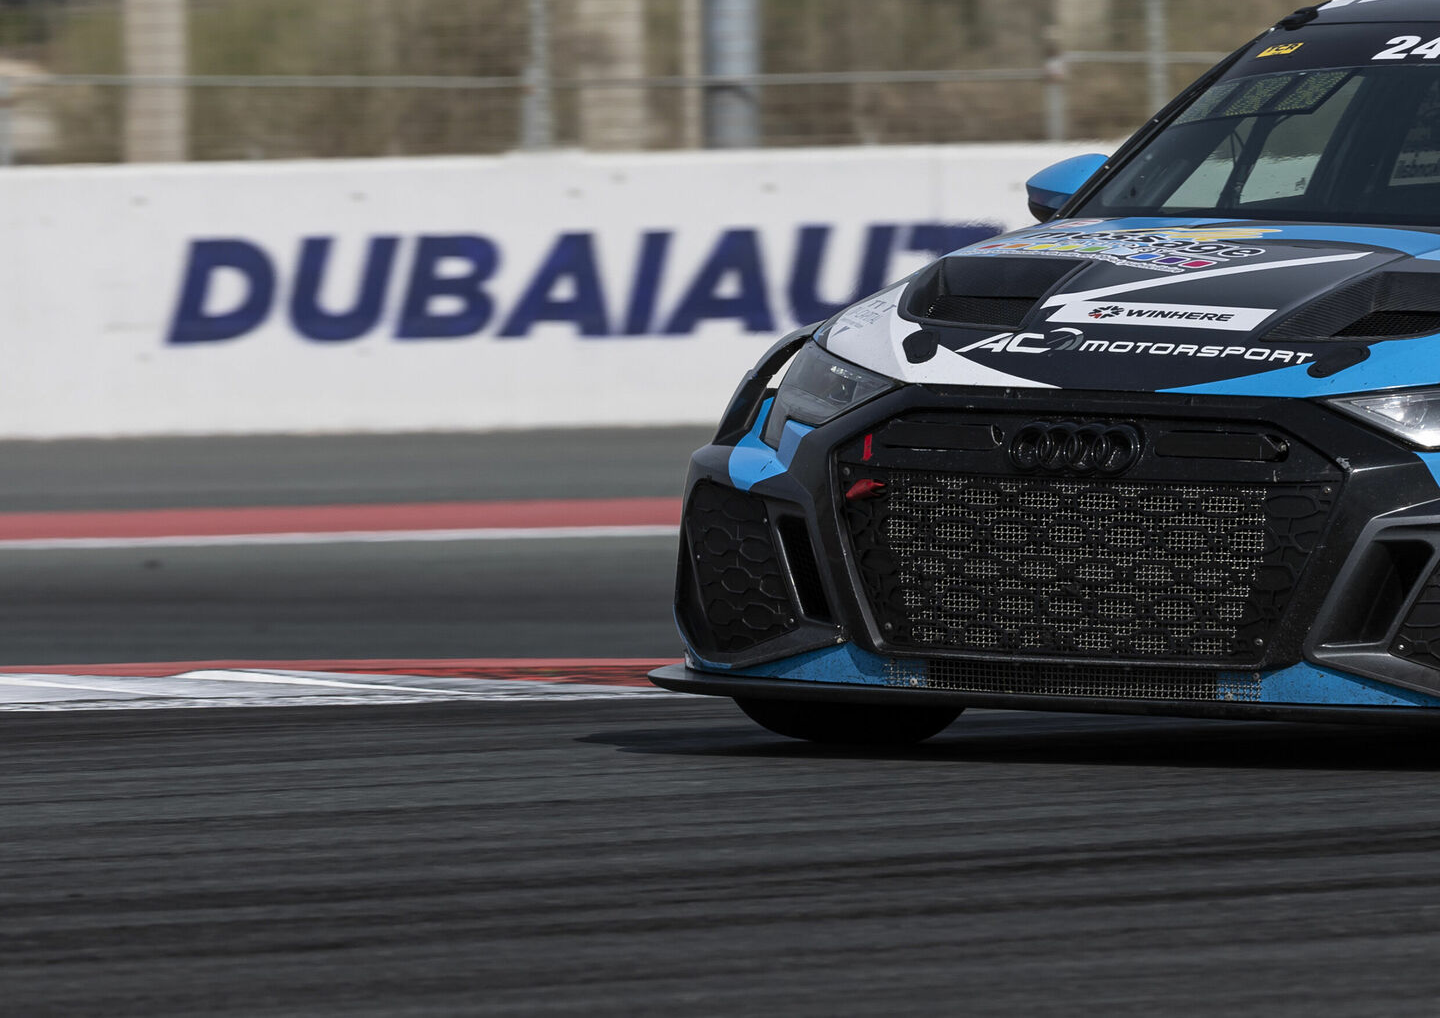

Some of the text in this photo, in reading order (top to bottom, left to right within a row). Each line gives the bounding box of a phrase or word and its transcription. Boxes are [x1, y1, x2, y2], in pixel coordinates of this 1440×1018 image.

[1125, 309, 1235, 322] WINHERE
[954, 332, 1314, 365] AC MOTORSPORT
